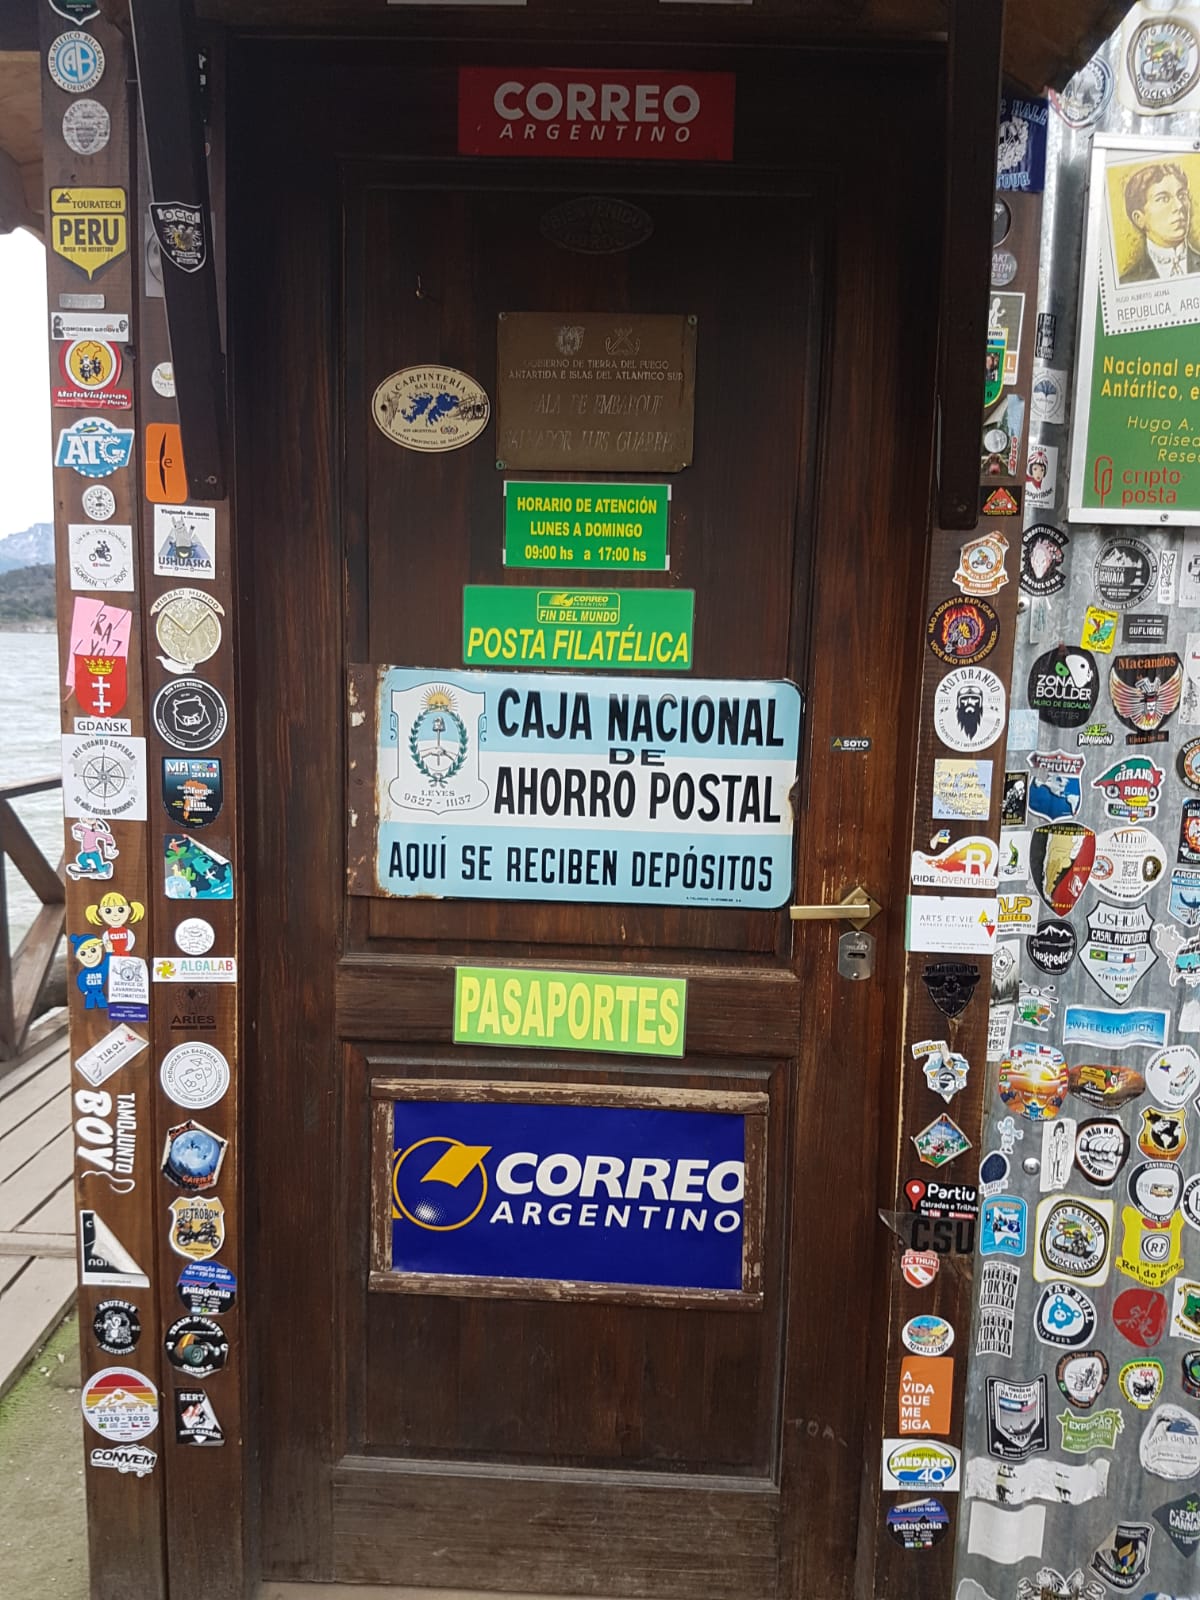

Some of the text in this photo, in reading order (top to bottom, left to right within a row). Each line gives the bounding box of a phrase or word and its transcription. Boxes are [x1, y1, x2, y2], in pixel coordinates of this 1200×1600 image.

[493, 81, 700, 124] CORREO
[499, 123, 690, 142] ARGENTINO
[72, 200, 122, 209] TOURATECH
[59, 218, 119, 247] PERU
[1117, 302, 1172, 321] REPUBLICA
[524, 359, 669, 371] GOBIERNO DE TIERRA DEL FUEGO
[1103, 355, 1179, 377] Nacional
[568, 370, 594, 380] ISLAS
[615, 371, 665, 382] ATLANTICO
[431, 383, 447, 391] LUIS
[1101, 378, 1183, 402] Antártico,
[1127, 415, 1195, 433] Hugo A.
[64, 435, 126, 464] ATG
[1122, 467, 1181, 490] cripto
[517, 496, 657, 514] HORARIO DE ATENCIÓN
[1121, 487, 1177, 508] posta
[530, 521, 643, 538] LUNES A DOMINGO
[159, 557, 212, 568] USHUASKA
[525, 545, 647, 562] 09:00 hs a 17:00 hs
[573, 595, 609, 603] CORREO
[539, 610, 617, 623] FIN DEL MUNDO
[936, 598, 963, 618] ADIANTA
[965, 597, 995, 620] EXPLICAR
[467, 624, 689, 663] POSTA FILATÉLICA
[944, 654, 958, 665] NÃO
[960, 657, 973, 665] IRIA
[940, 669, 1000, 695] MOTORANDO
[1038, 675, 1074, 686] ZONA
[1036, 687, 1091, 701] BOULDER
[78, 718, 128, 732] GDAŃSK
[496, 687, 785, 747] CAJA NACIONAL
[609, 748, 666, 767] DE
[493, 766, 781, 823] AHORRO POSTAL
[1124, 786, 1148, 796] RODA
[388, 835, 774, 892] AQUÍ SE RECIBEN DEPÓSITOS
[960, 916, 974, 924] VIE
[1091, 930, 1114, 941] CASAL
[181, 960, 233, 971] ALGALAB
[459, 976, 680, 1048] PASAPORTES
[99, 1040, 124, 1061] TIROL
[75, 1090, 113, 1171] BOY
[115, 1092, 137, 1174] TAMOJUNTO
[495, 1151, 745, 1206] CORREO
[927, 1183, 976, 1201] Partiu
[921, 1200, 949, 1211] Estradas
[489, 1201, 741, 1233] ARGENTINO
[1071, 1208, 1103, 1237] ESTRADA
[911, 1220, 975, 1253] CSU
[915, 1258, 937, 1268] THUN
[1049, 1251, 1100, 1272] MOTOCICLISMO
[1122, 1260, 1157, 1279] Rei do
[182, 1286, 232, 1298] patagonia
[1073, 1292, 1094, 1323] BULL
[903, 1371, 913, 1381] A
[902, 1383, 935, 1394] VIDA
[901, 1395, 930, 1407] QUE
[901, 1407, 921, 1418] ME
[901, 1419, 931, 1430] SIGA
[92, 1450, 156, 1465] CONVEM
[918, 1468, 946, 1482] 40
[893, 1521, 943, 1531] patagonia
